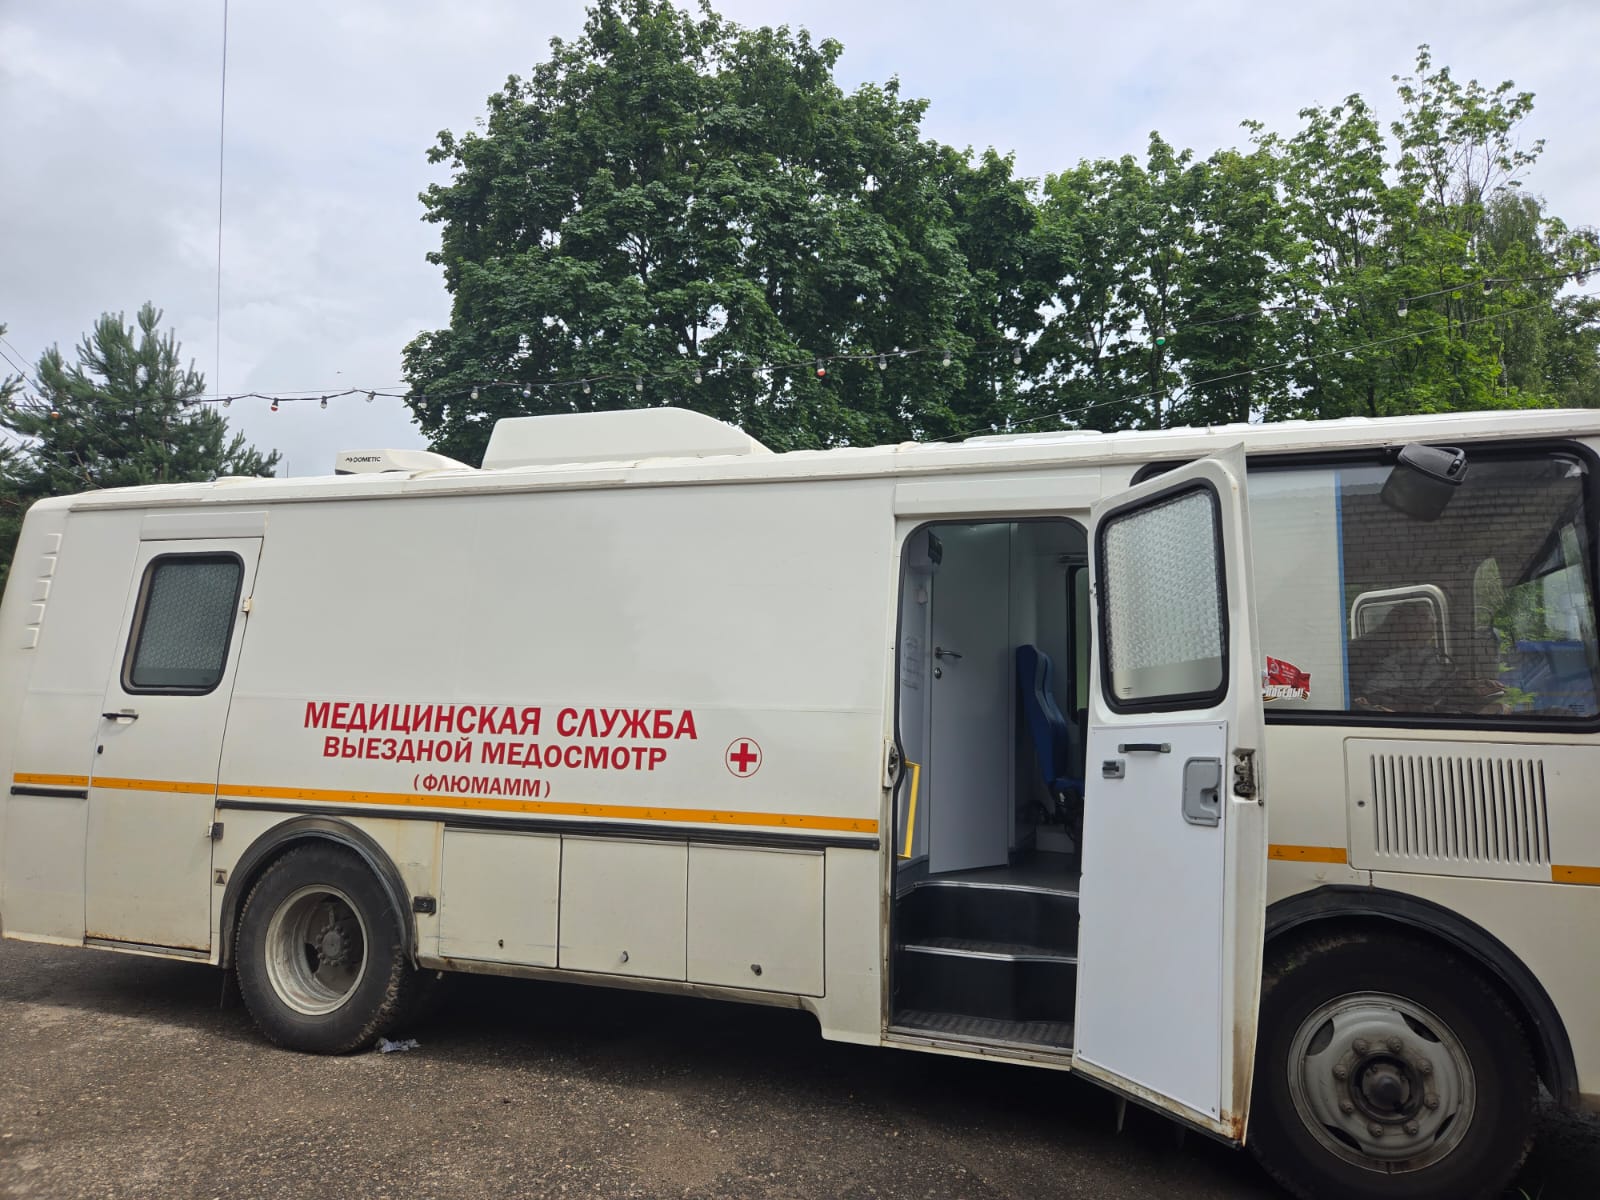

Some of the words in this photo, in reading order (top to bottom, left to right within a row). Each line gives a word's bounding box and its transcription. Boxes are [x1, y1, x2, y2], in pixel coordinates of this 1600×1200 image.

[304, 701, 541, 736] МЕДИЦИНСКАЯ
[556, 707, 698, 740] СЛУЖБА
[322, 735, 472, 764] ВЫЕЗДНОЙ
[481, 741, 667, 771] МЕДОСМОТР
[413, 774, 551, 799] (ФЛЮМАММ)
